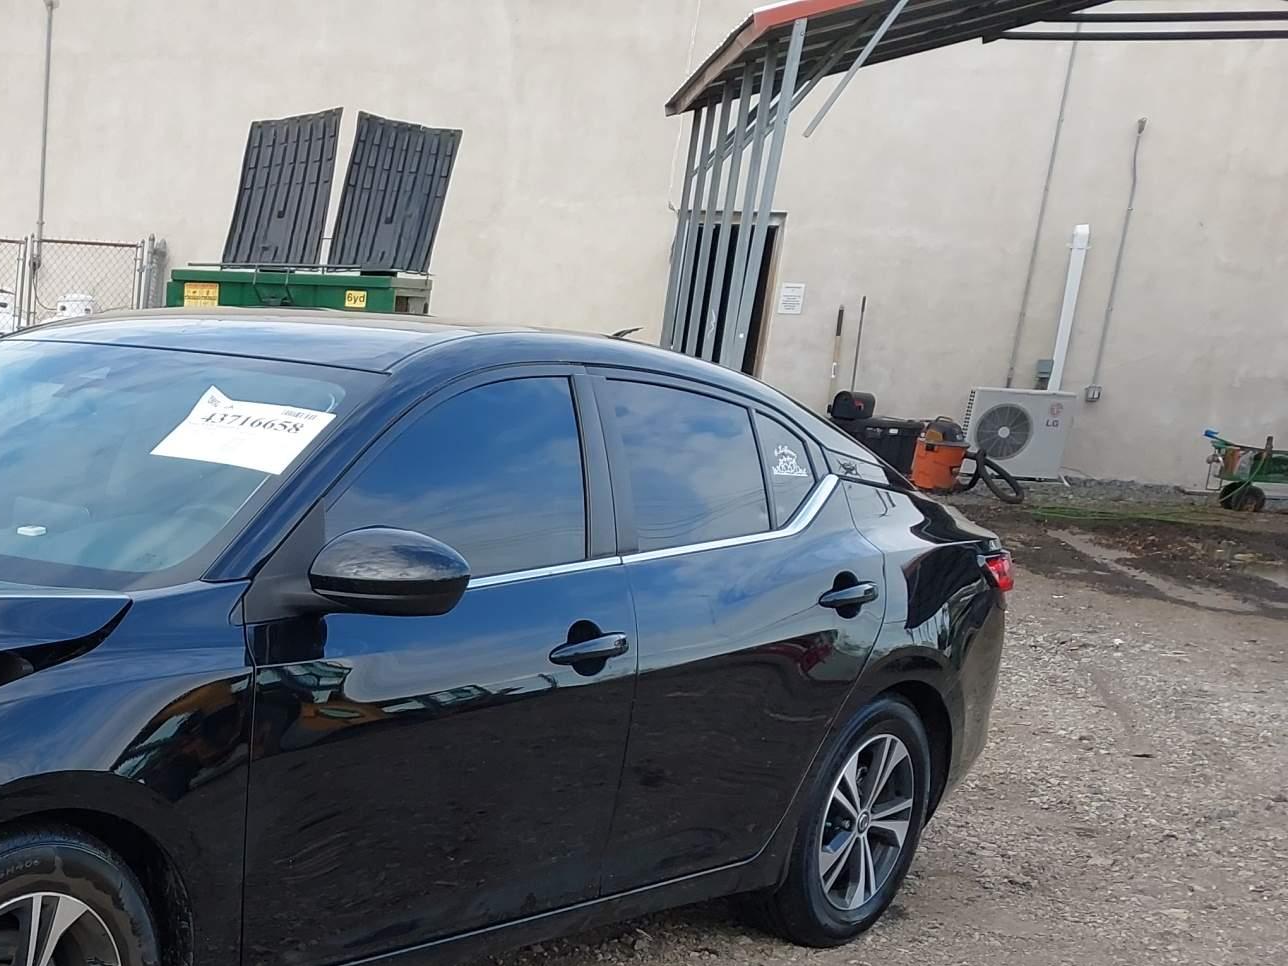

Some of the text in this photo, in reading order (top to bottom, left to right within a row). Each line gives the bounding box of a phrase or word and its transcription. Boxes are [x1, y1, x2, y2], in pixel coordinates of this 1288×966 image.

[347, 292, 365, 304] 6yd
[200, 412, 305, 434] 43716658
[1046, 419, 1059, 427] LG
